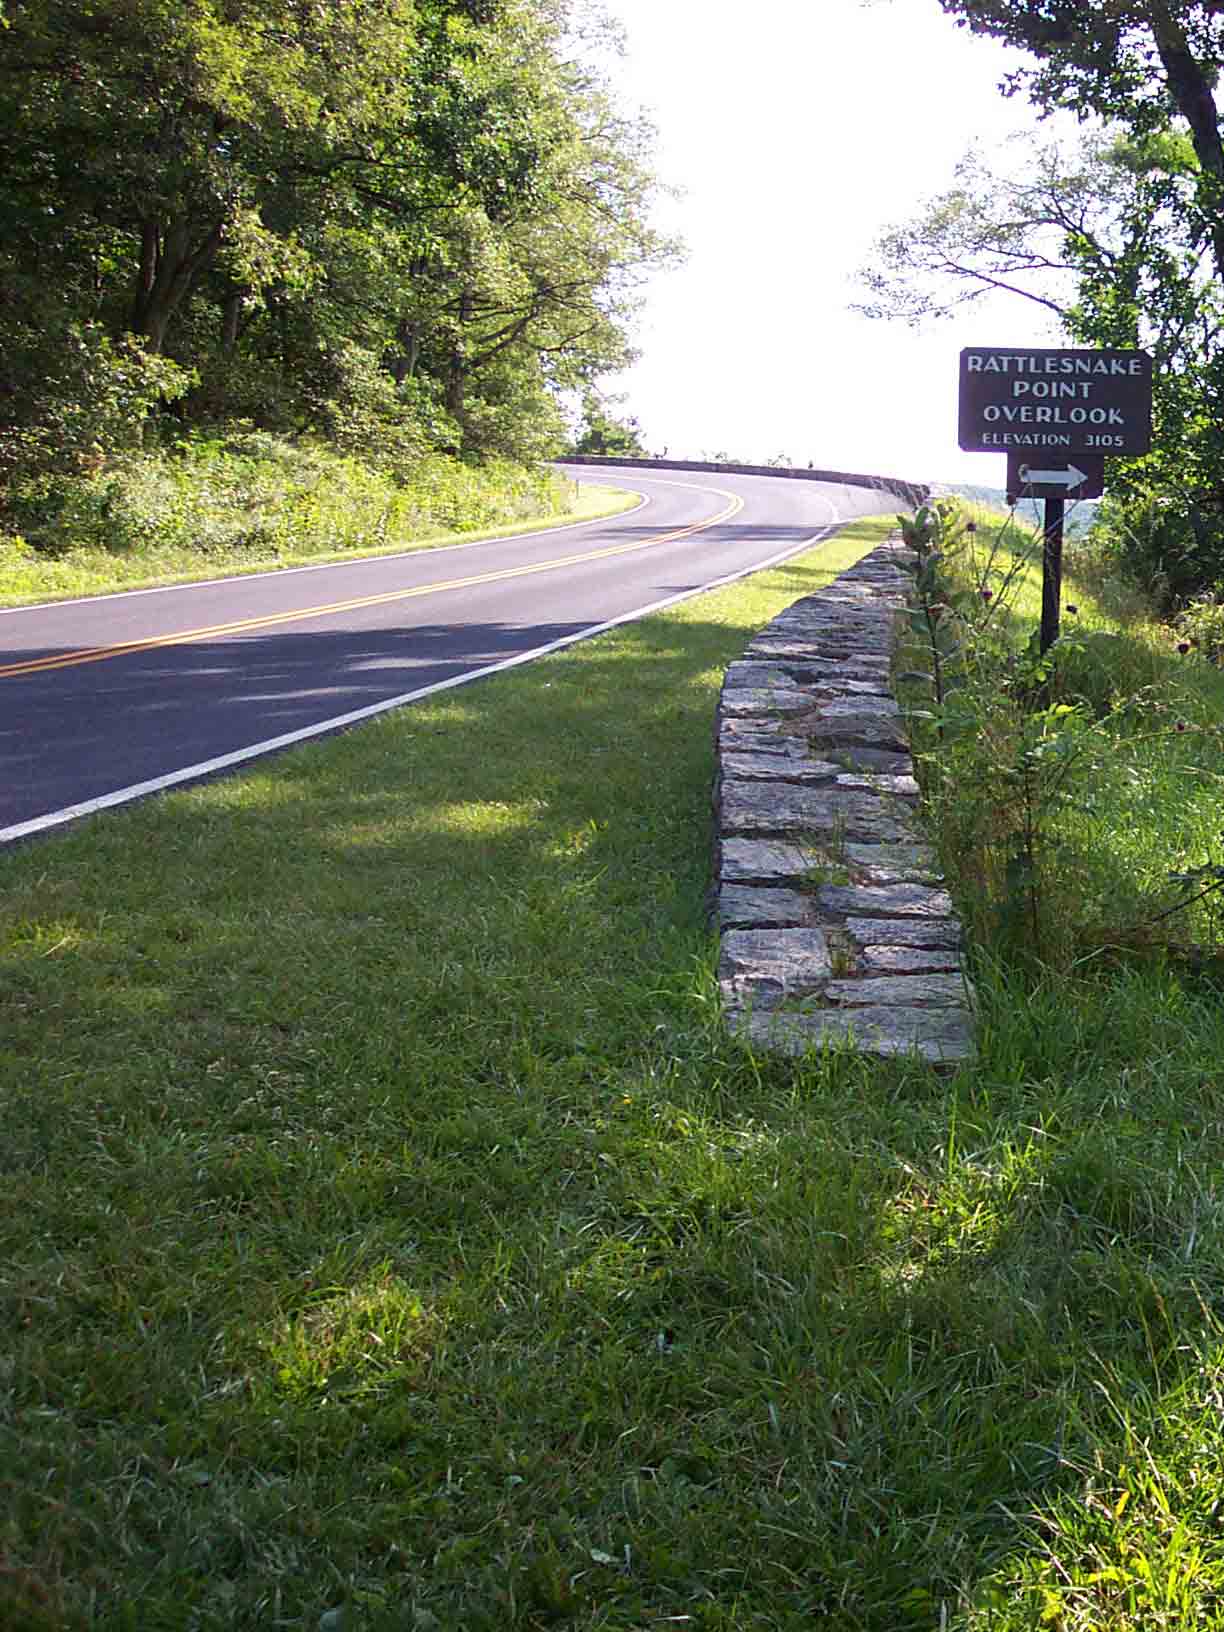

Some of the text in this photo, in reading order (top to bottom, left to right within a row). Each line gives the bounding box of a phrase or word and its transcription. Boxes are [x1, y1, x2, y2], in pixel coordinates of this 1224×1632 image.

[967, 355, 1144, 375] RATTLESNAKE
[1013, 380, 1094, 398] POINT
[983, 405, 1124, 425] OVERLOOK
[982, 432, 1124, 447] ELEVATION 3105
